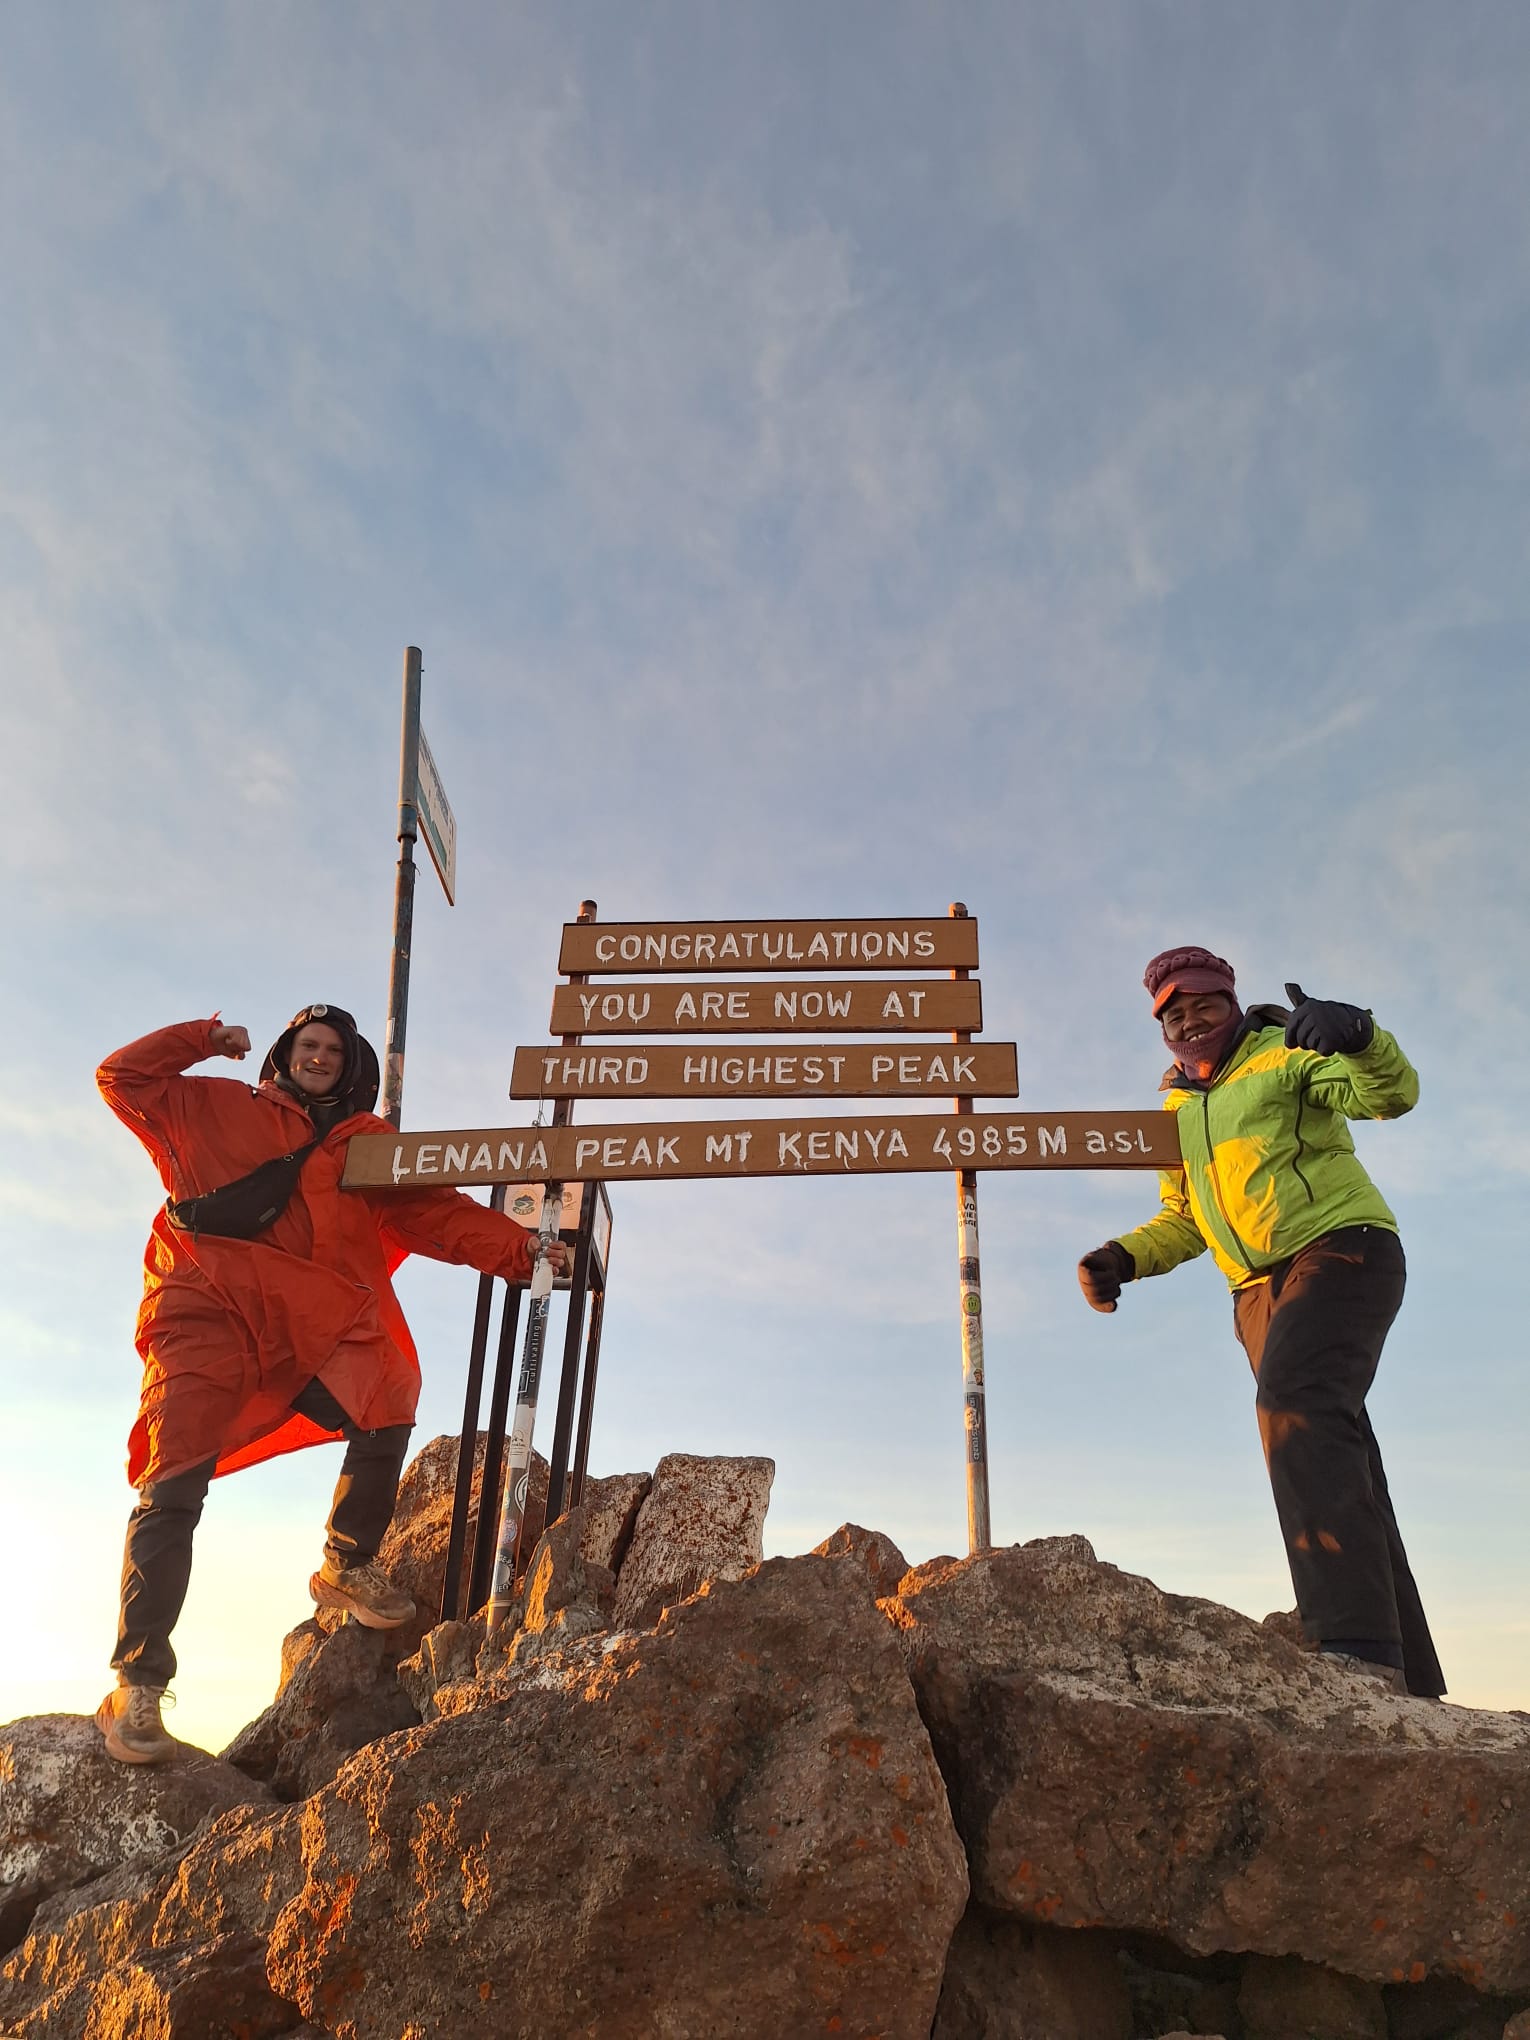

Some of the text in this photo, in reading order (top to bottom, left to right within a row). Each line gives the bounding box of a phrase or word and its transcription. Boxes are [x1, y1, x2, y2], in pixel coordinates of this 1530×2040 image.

[595, 931, 936, 965] CONGRATULATIONS
[579, 990, 926, 1024] YOU ARE NOW AT
[541, 1055, 977, 1086] THIRD HIGHEST PEAK
[391, 1140, 548, 1179] LENANA
[575, 1136, 681, 1170] PEAK
[705, 1131, 753, 1163] MT
[777, 1128, 910, 1165] KENYA
